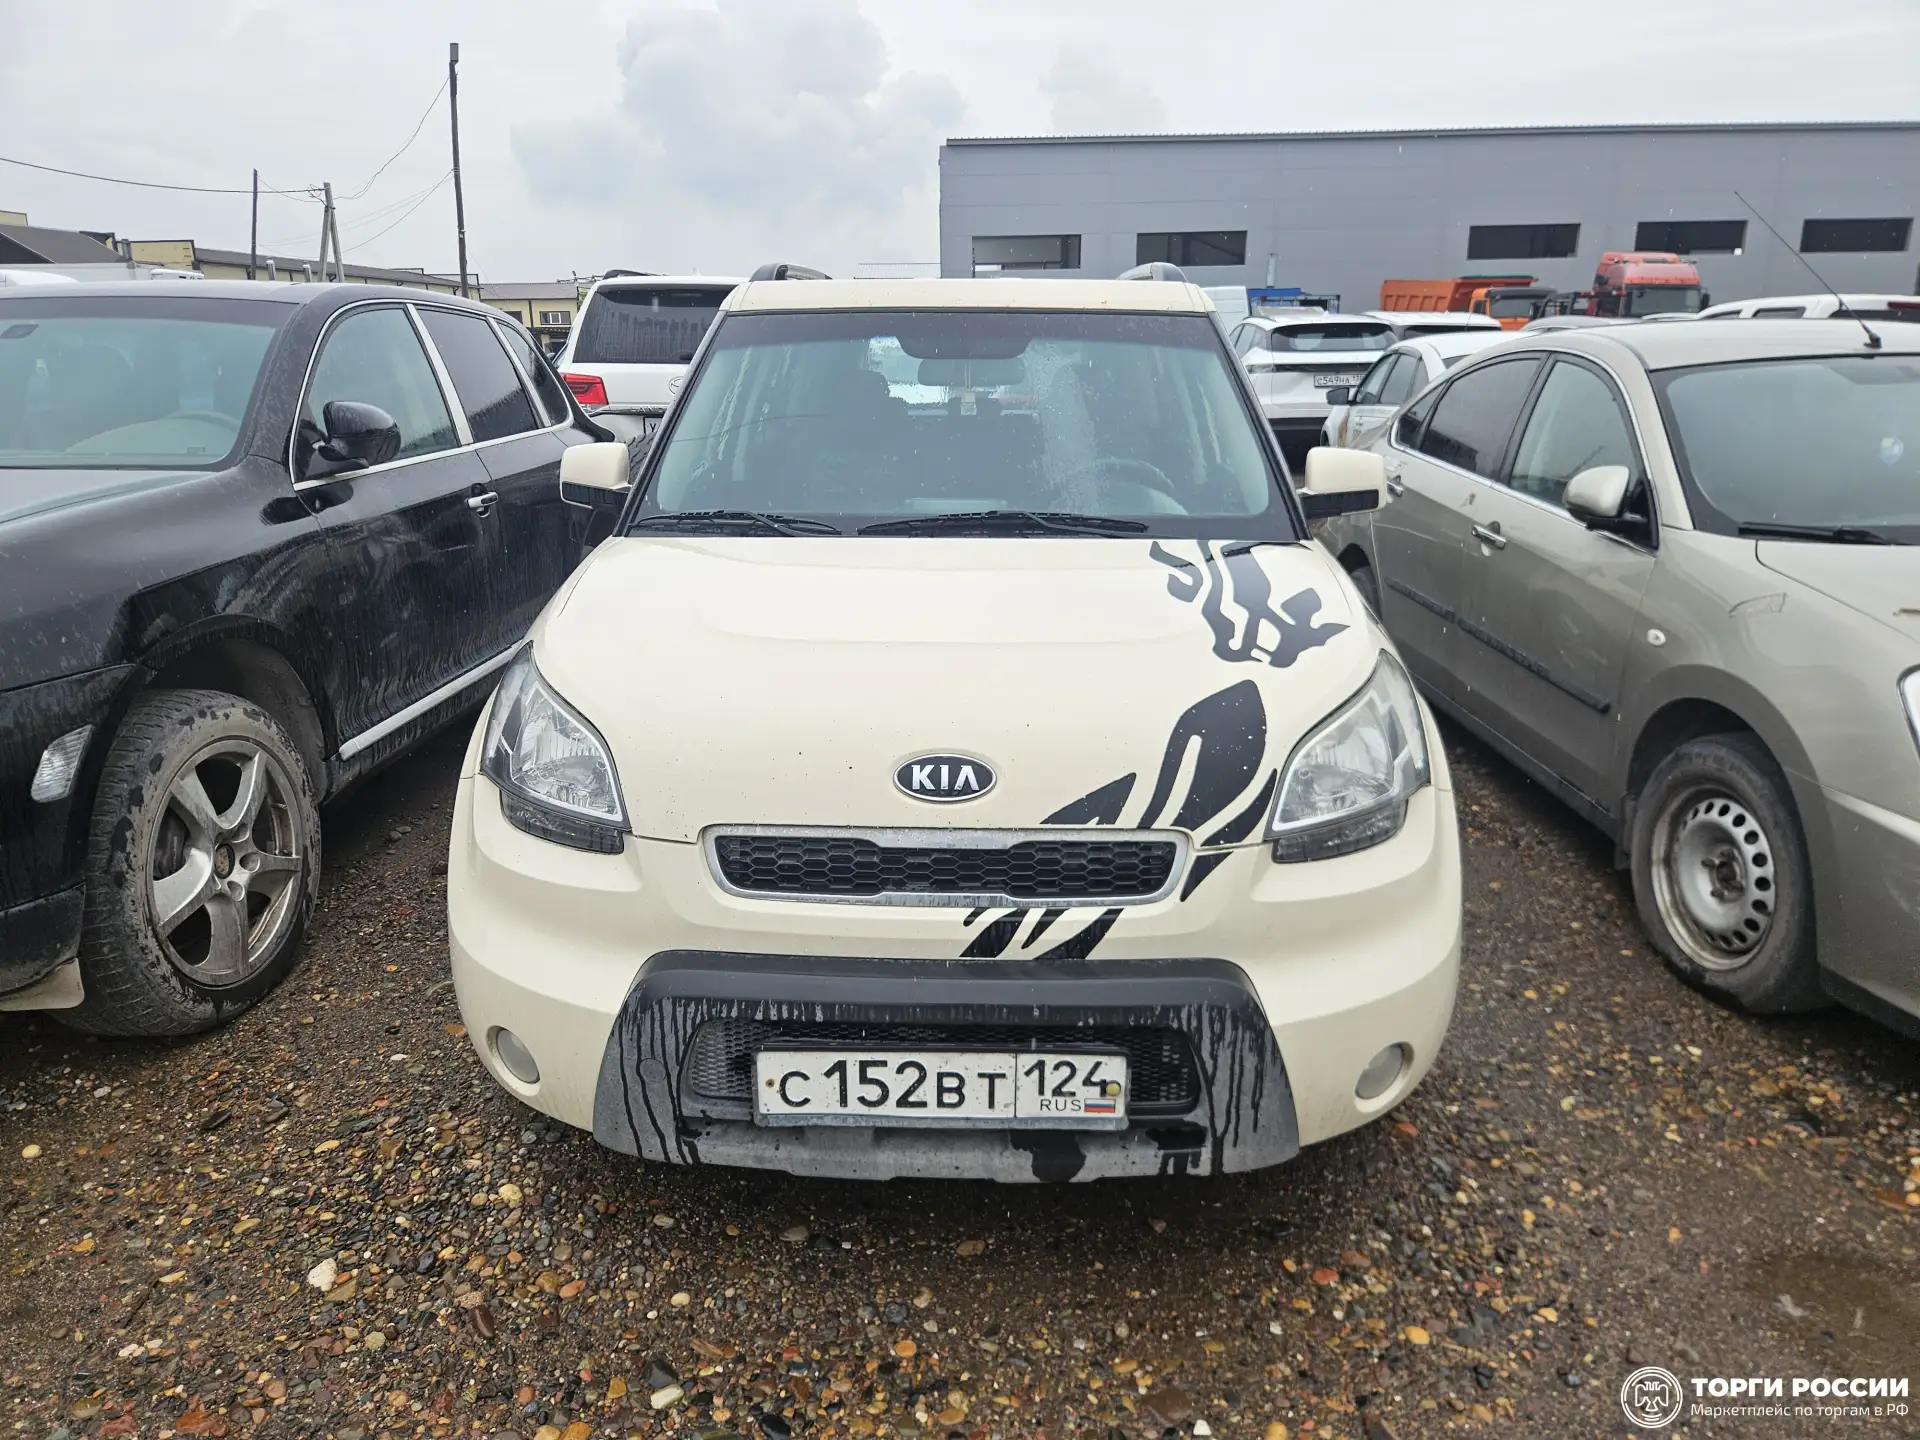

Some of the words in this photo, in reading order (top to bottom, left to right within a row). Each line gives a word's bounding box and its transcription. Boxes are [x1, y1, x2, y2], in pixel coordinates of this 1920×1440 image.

[911, 764, 980, 791] KIA
[779, 1060, 1007, 1109] С152ВТ
[1024, 1060, 1108, 1097] 124
[1040, 1098, 1082, 1112] RUS
